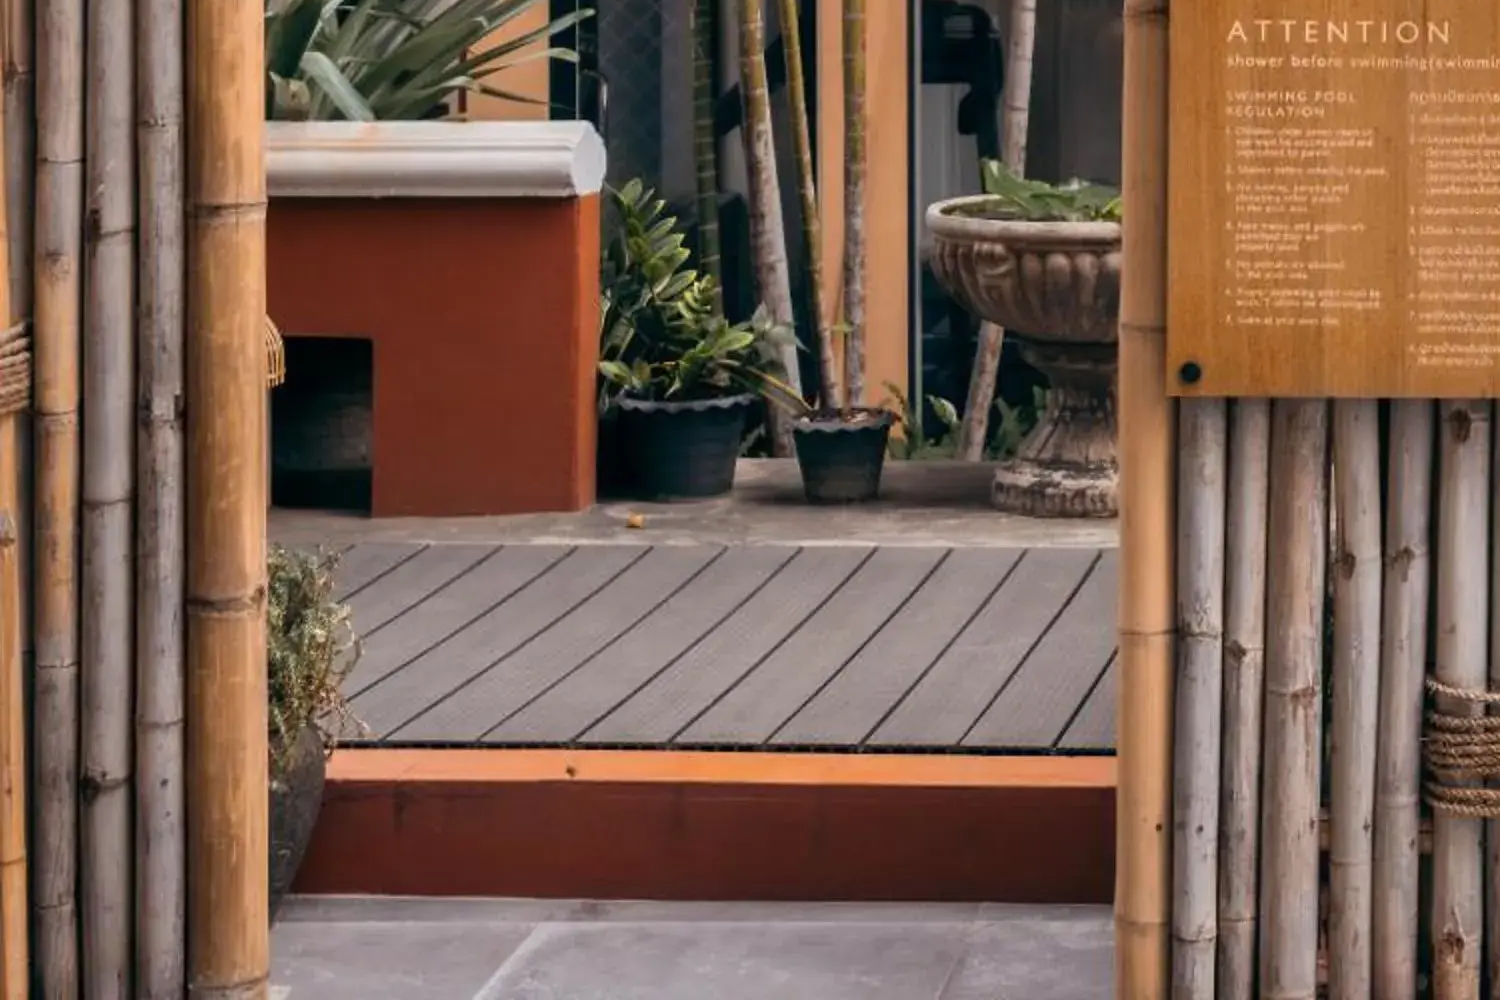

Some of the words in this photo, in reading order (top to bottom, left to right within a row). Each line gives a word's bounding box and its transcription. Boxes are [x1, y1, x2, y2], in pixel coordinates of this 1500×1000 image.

[1226, 20, 1451, 44] ATTENTION
[1226, 53, 1285, 68] shower
[1290, 53, 1342, 69] before
